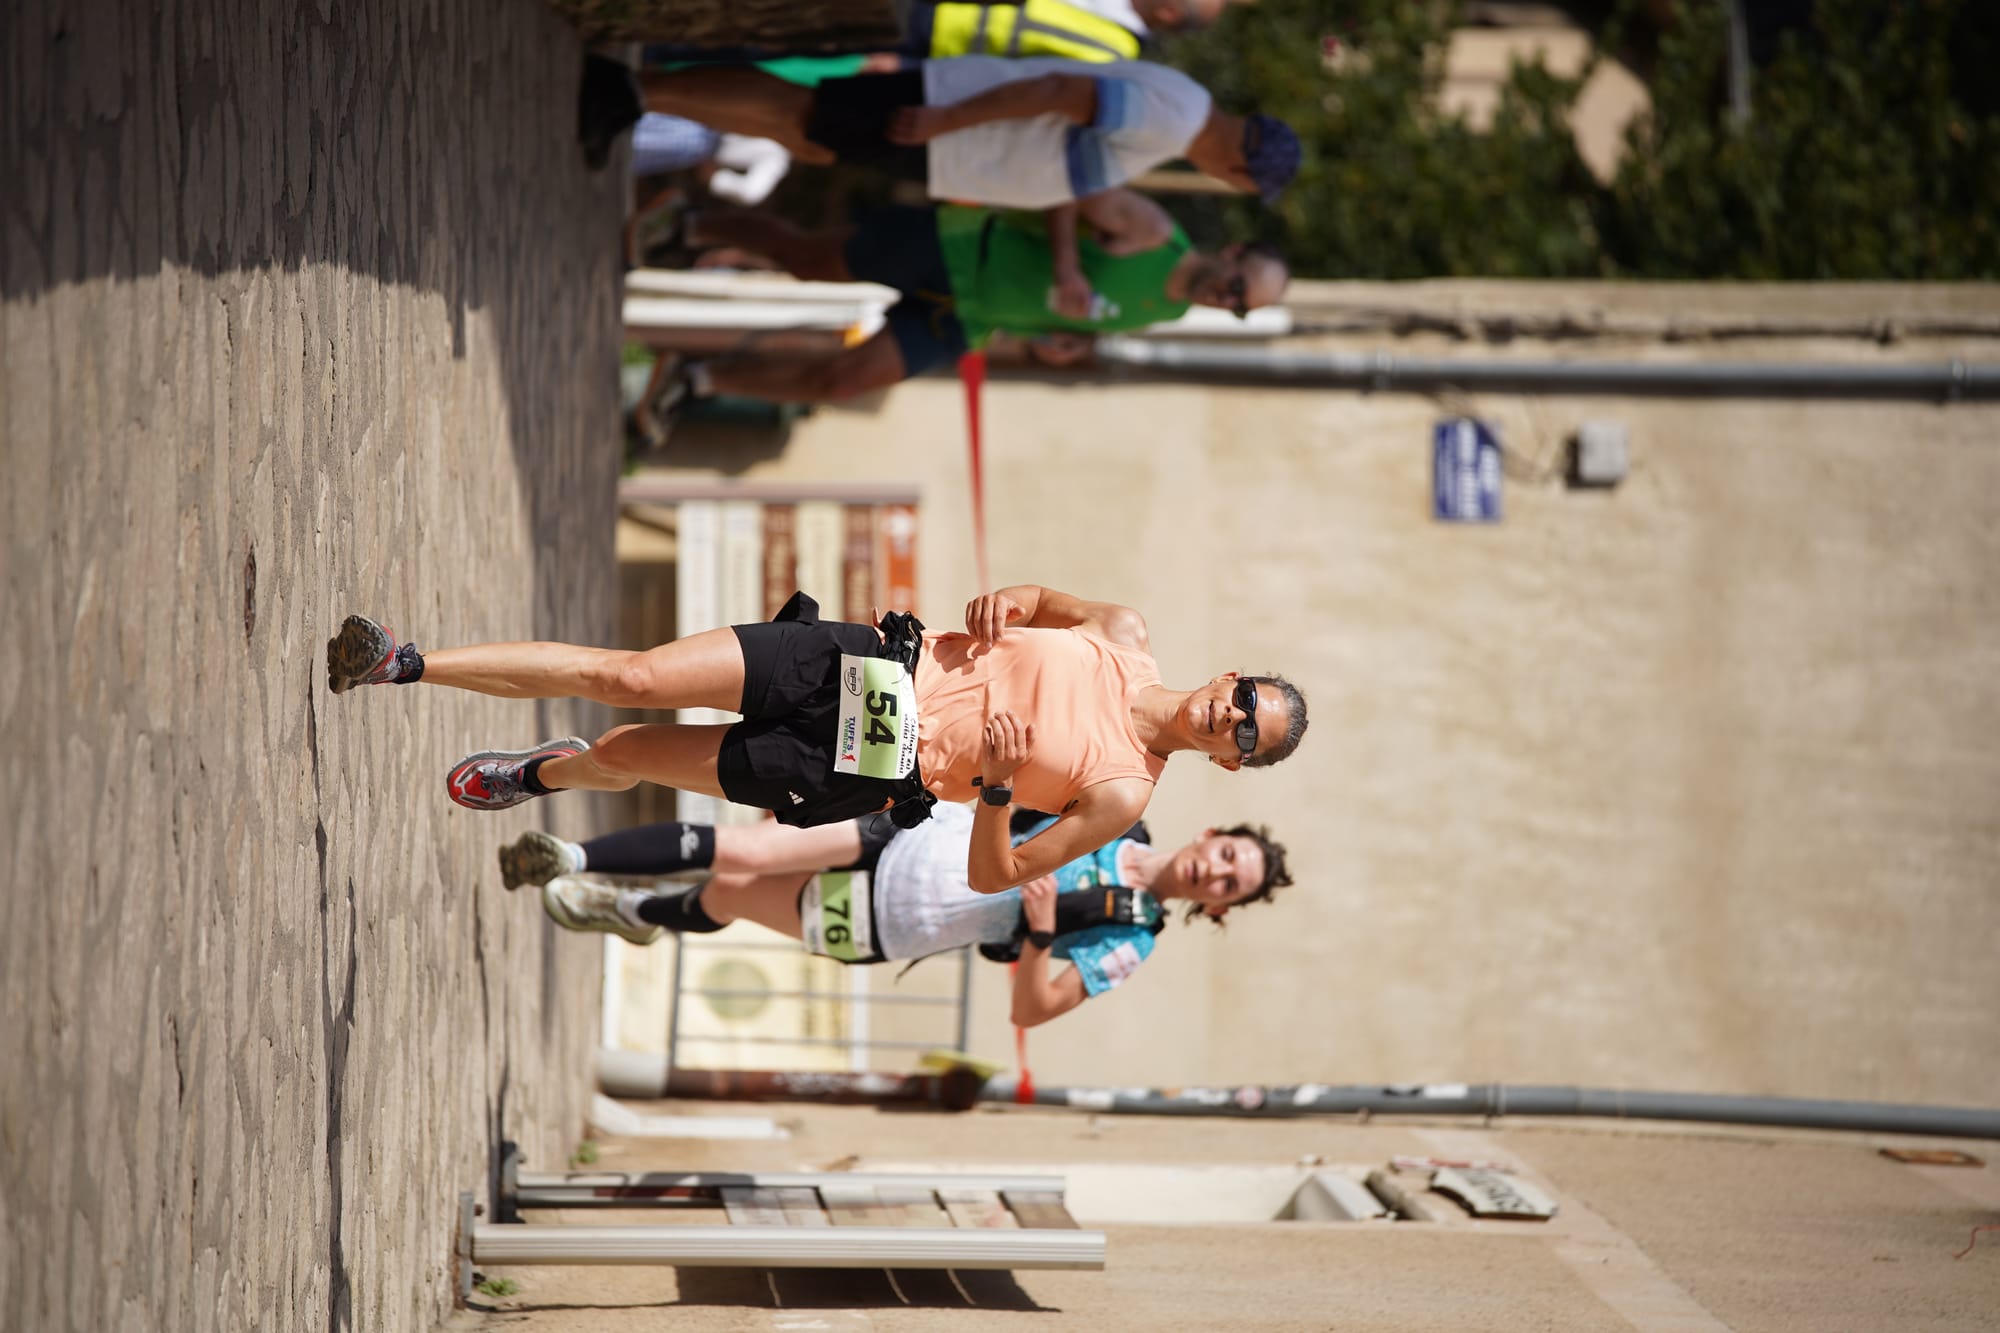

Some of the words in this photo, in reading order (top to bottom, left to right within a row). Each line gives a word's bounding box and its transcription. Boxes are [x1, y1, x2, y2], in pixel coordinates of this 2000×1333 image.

[842, 718, 850, 754] Aventure
[847, 716, 856, 751] TUFF'S
[865, 690, 897, 746] 54
[907, 718, 916, 754] Challenge
[824, 899, 850, 944] 76
